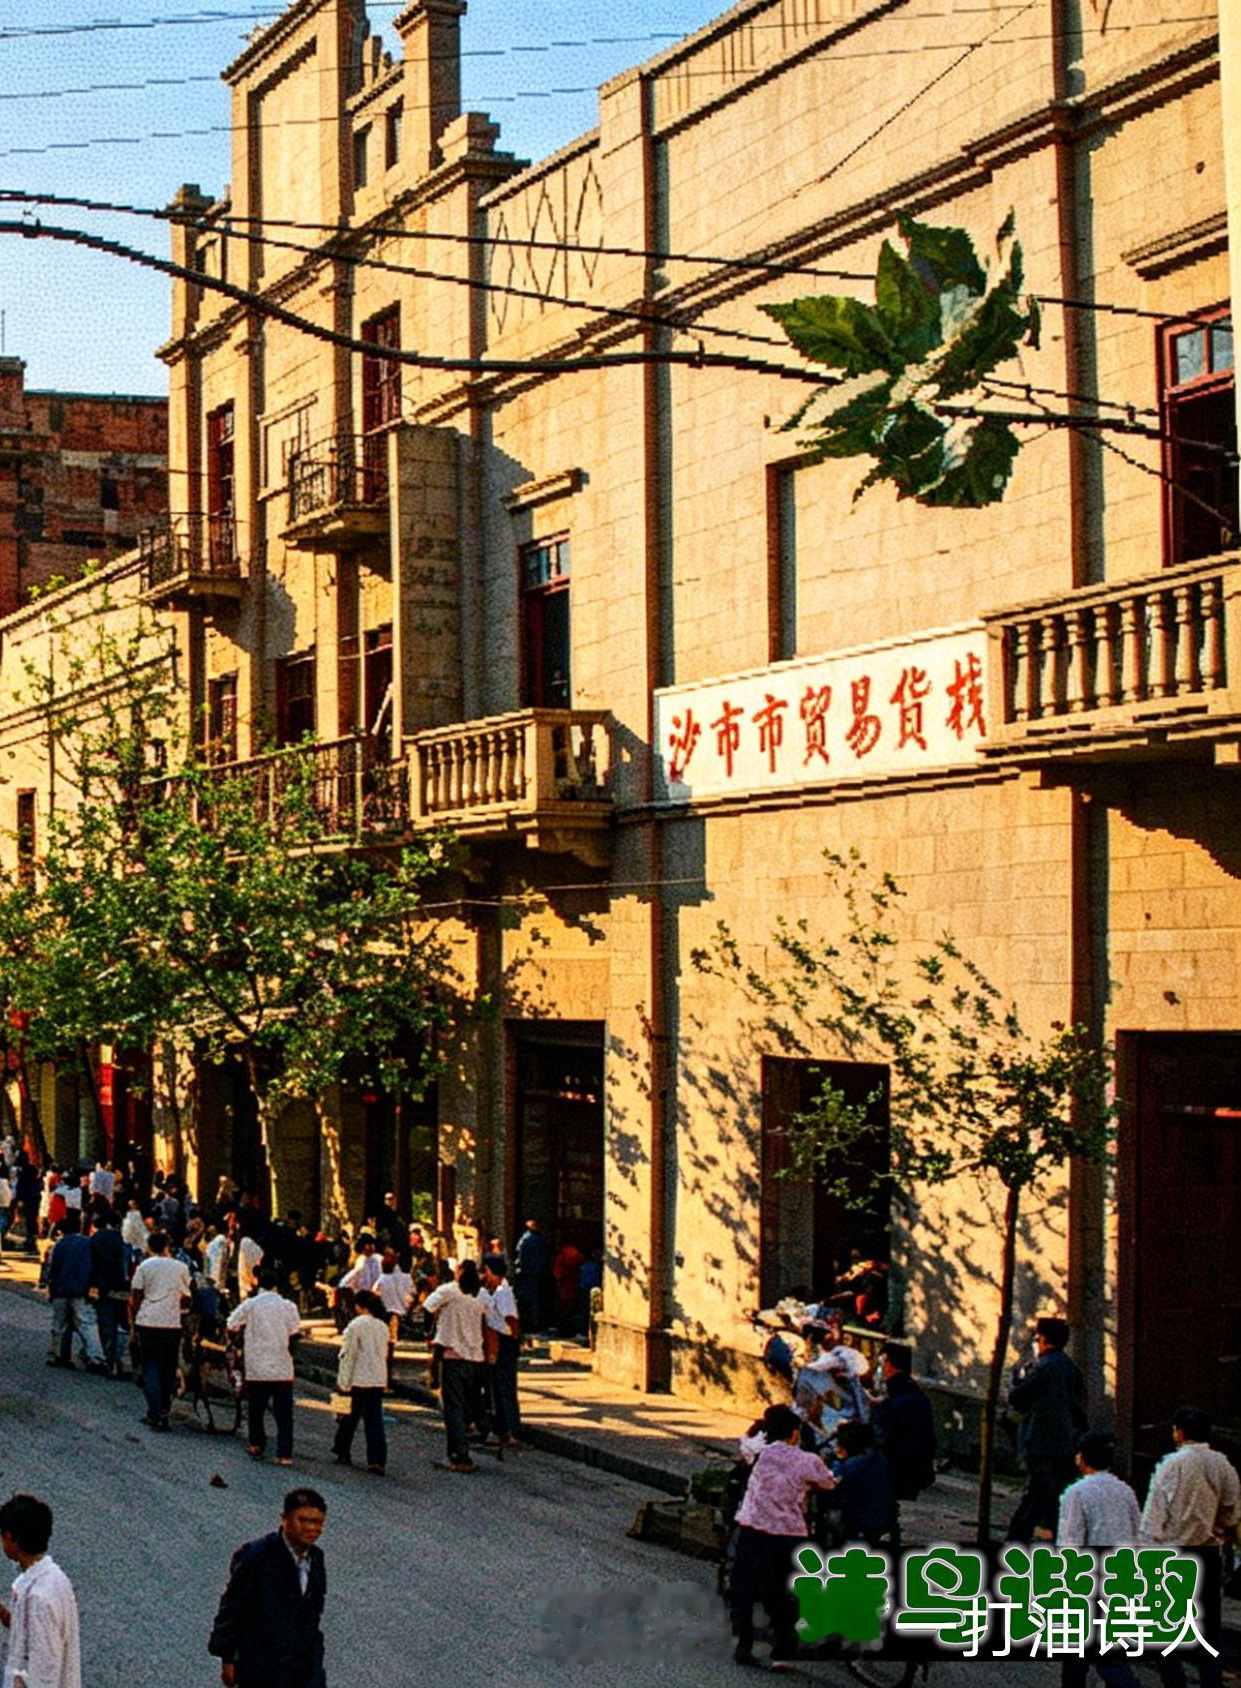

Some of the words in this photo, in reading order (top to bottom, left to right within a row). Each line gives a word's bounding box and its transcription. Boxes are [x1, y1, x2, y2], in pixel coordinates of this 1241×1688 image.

[668, 651, 987, 782] 沙市市贸易货栈
